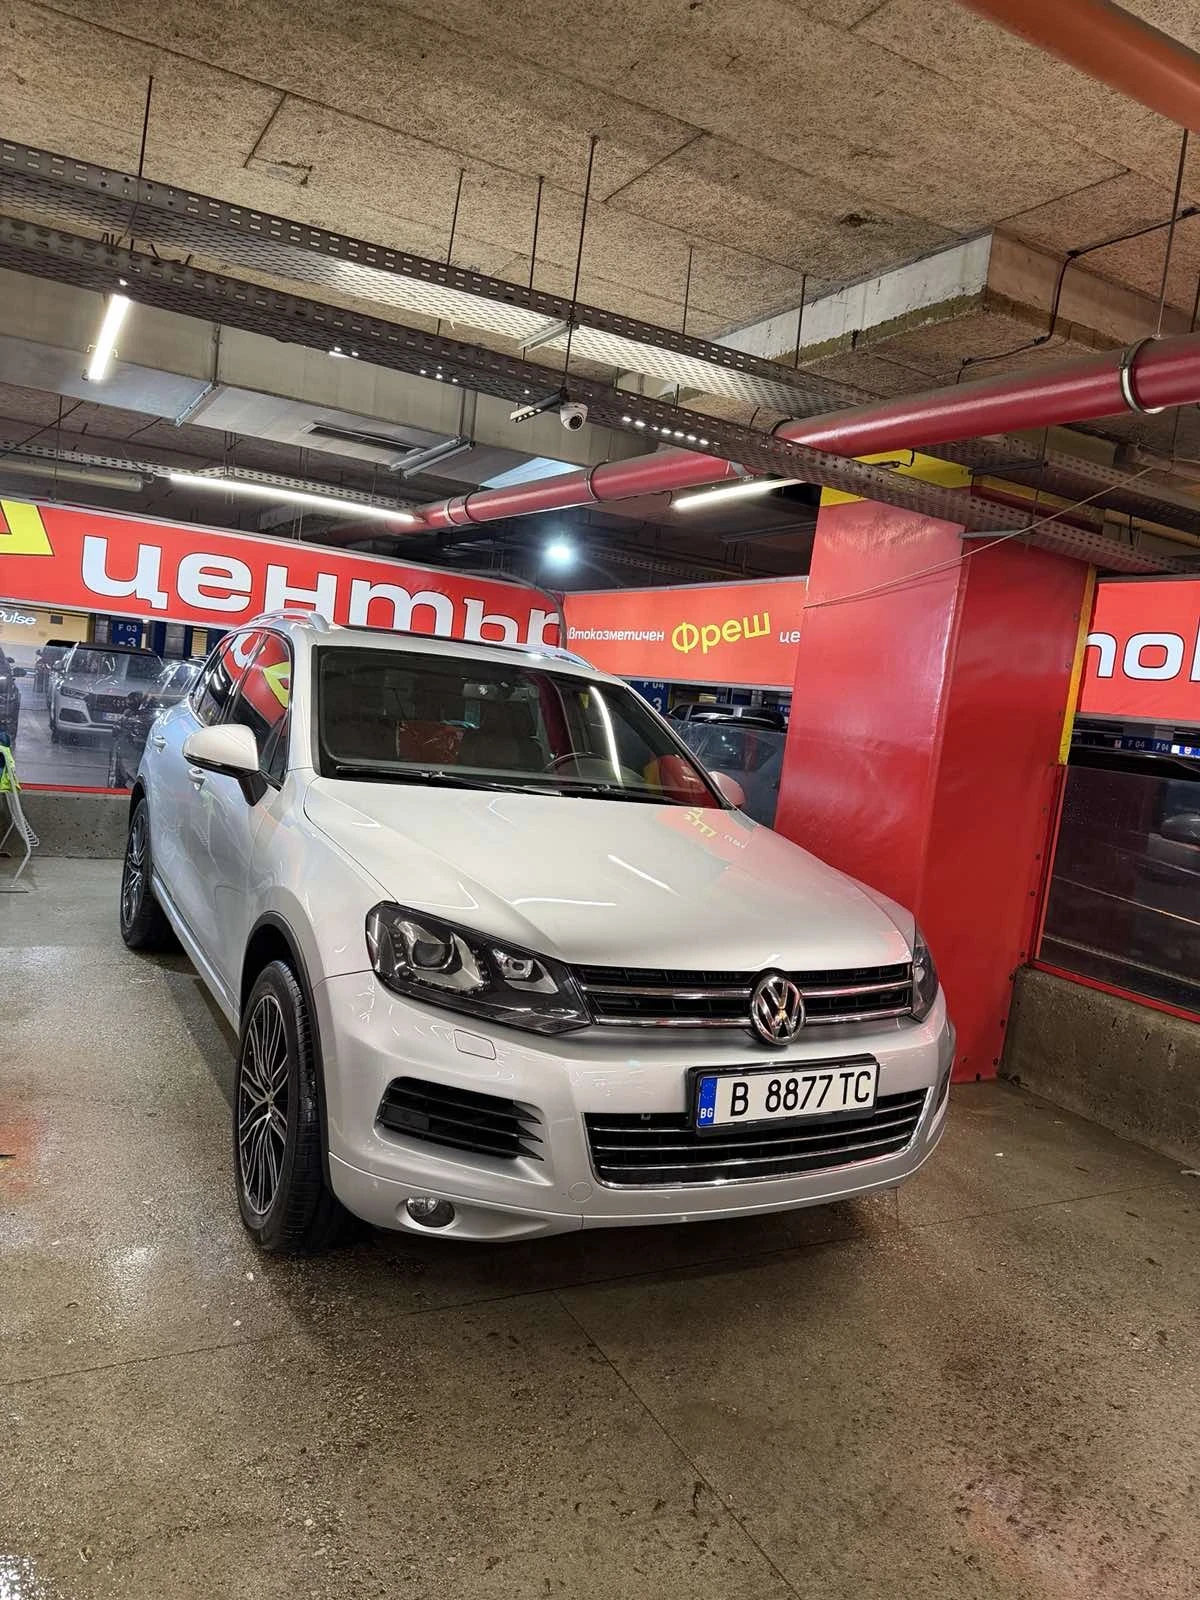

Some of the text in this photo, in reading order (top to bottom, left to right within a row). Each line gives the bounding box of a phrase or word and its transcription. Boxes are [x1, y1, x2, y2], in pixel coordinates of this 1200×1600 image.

[126, 625, 137, 633] 03
[566, 626, 665, 641] втокозметичен
[671, 612, 771, 654] Фреш
[730, 1070, 872, 1117] B 8877 TC
[700, 1107, 714, 1119] BG
